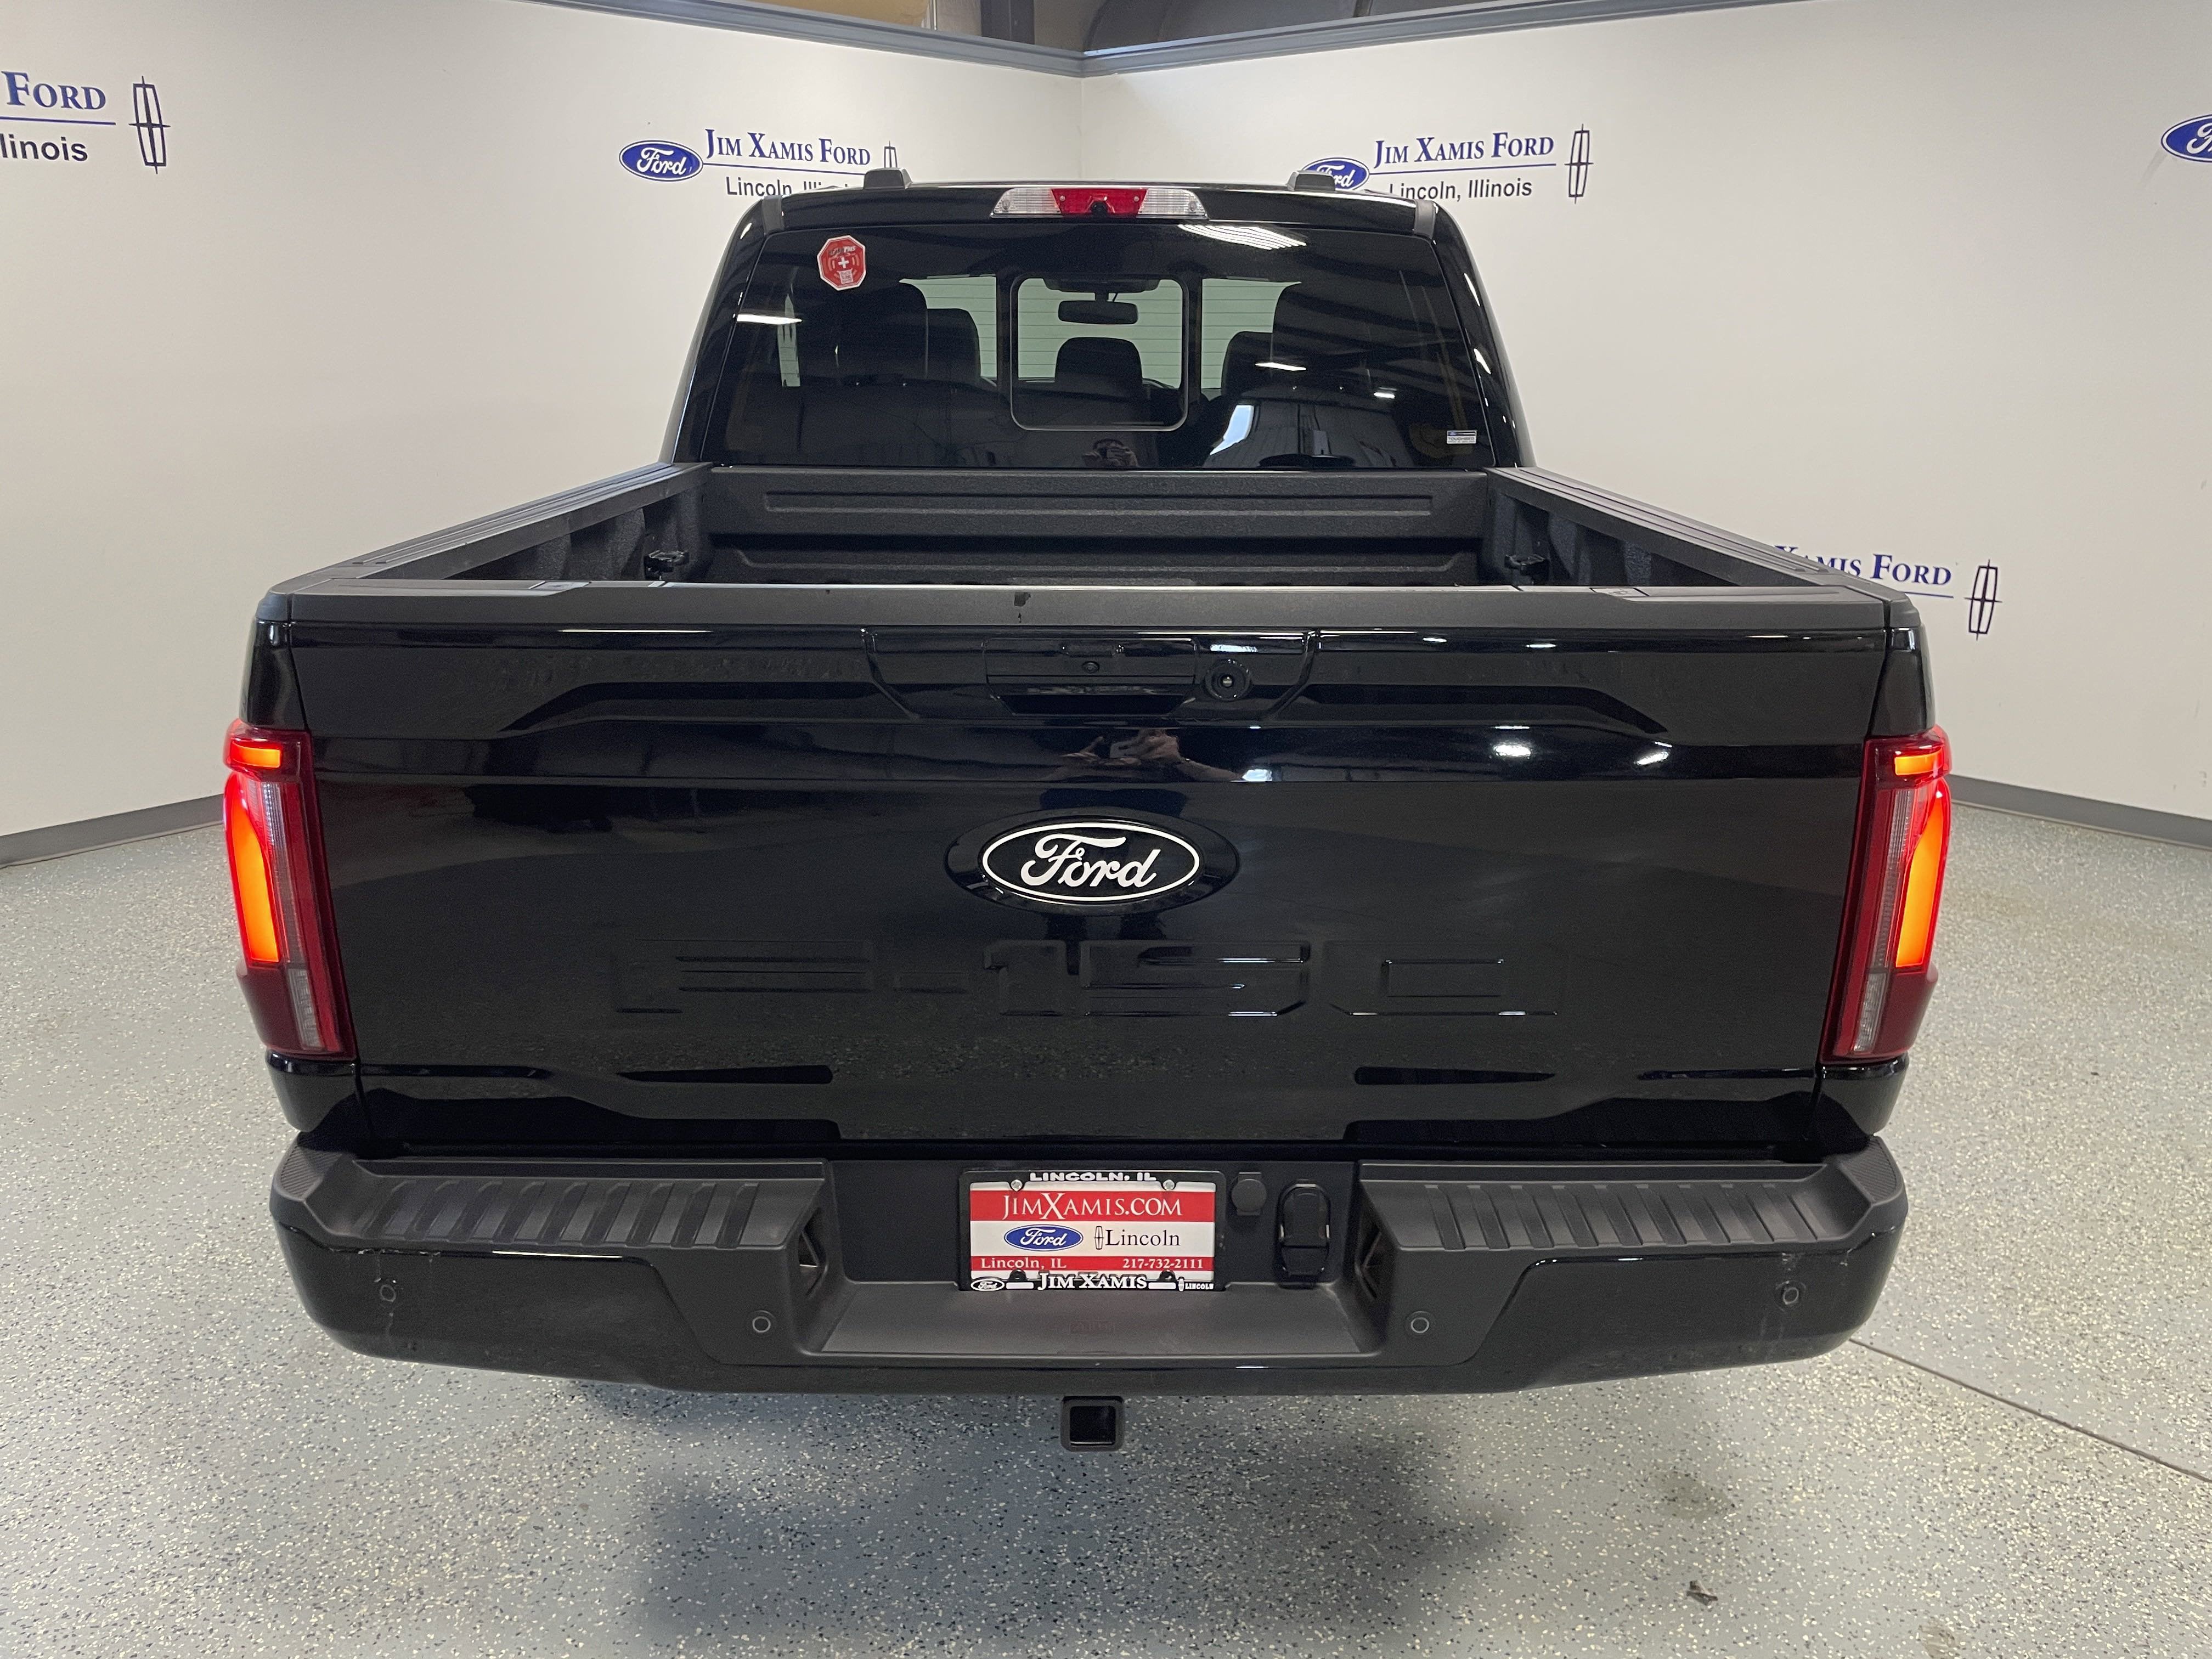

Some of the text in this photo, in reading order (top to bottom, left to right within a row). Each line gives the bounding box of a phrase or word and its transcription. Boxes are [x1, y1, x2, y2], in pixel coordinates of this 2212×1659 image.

[2, 71, 106, 110] FORD
[706, 128, 871, 166] JIM XAMIS FORD
[1374, 132, 1554, 168] JIM XAMIS FORD
[636, 147, 687, 175] Ford
[1469, 177, 1532, 199] Illinois
[1871, 554, 1952, 585] FORD
[1020, 833, 1161, 888] Ford
[1137, 1172, 1156, 1181] IL
[1002, 1193, 1182, 1220] JIMXAMIS.COM
[1020, 1228, 1067, 1246] Ford
[1105, 1229, 1181, 1246] Lincoln
[981, 1258, 1066, 1270] Lincoln, IL
[1122, 1259, 1203, 1269] 217-732-2111
[978, 1281, 998, 1289] Ford
[1037, 1273, 1147, 1290] JIM XAMIS
